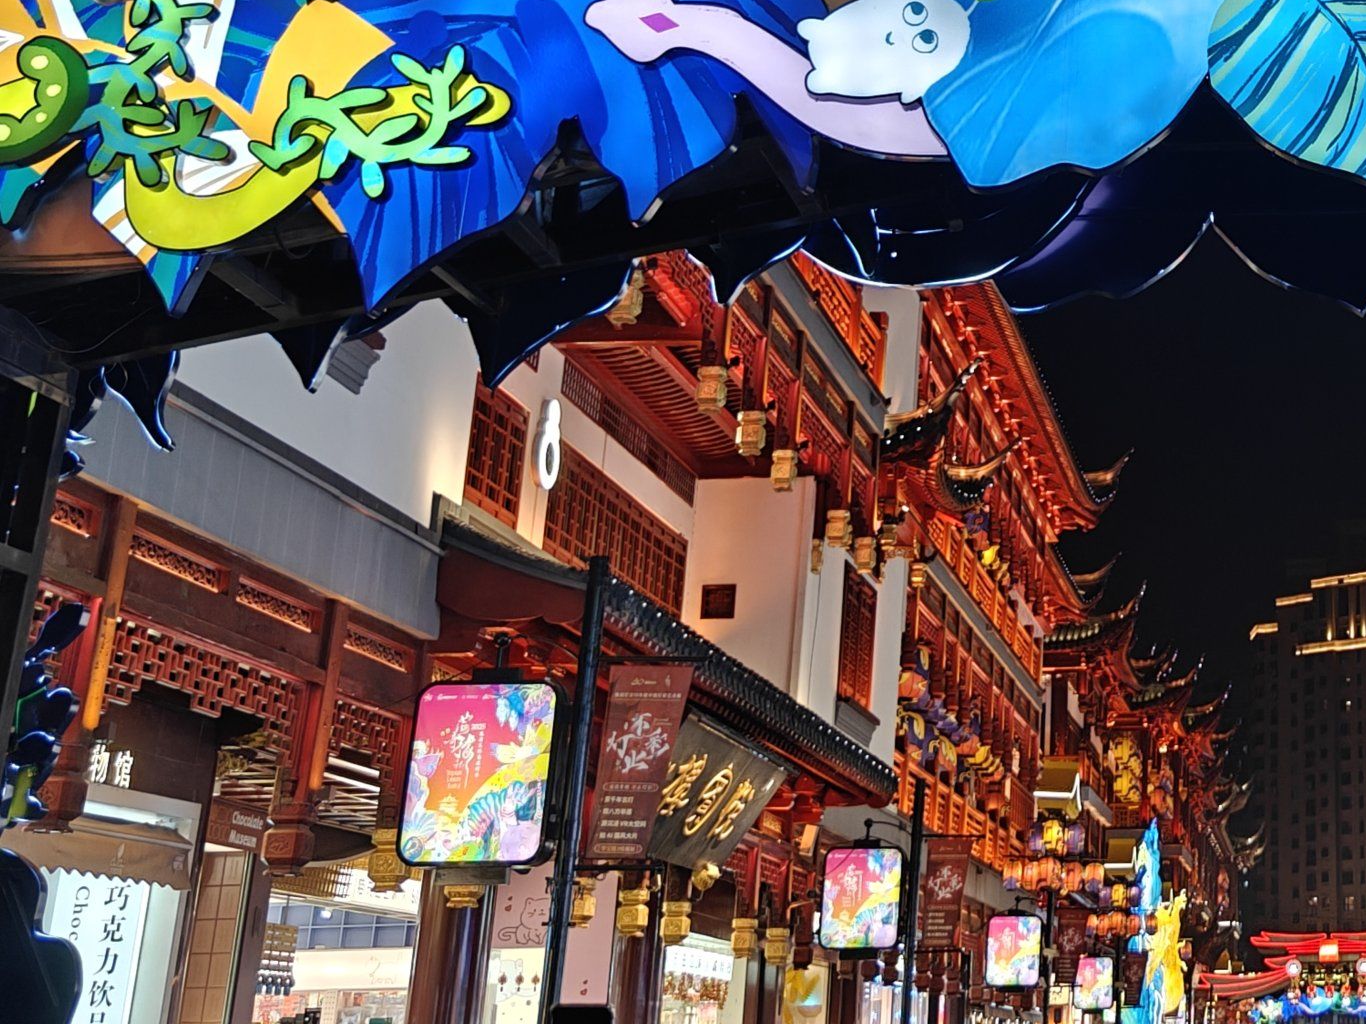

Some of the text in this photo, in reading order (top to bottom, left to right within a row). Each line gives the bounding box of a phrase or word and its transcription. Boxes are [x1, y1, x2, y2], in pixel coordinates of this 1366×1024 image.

[88, 744, 134, 789] 物馆
[232, 810, 264, 831] Chocolate
[228, 829, 257, 848] Museum
